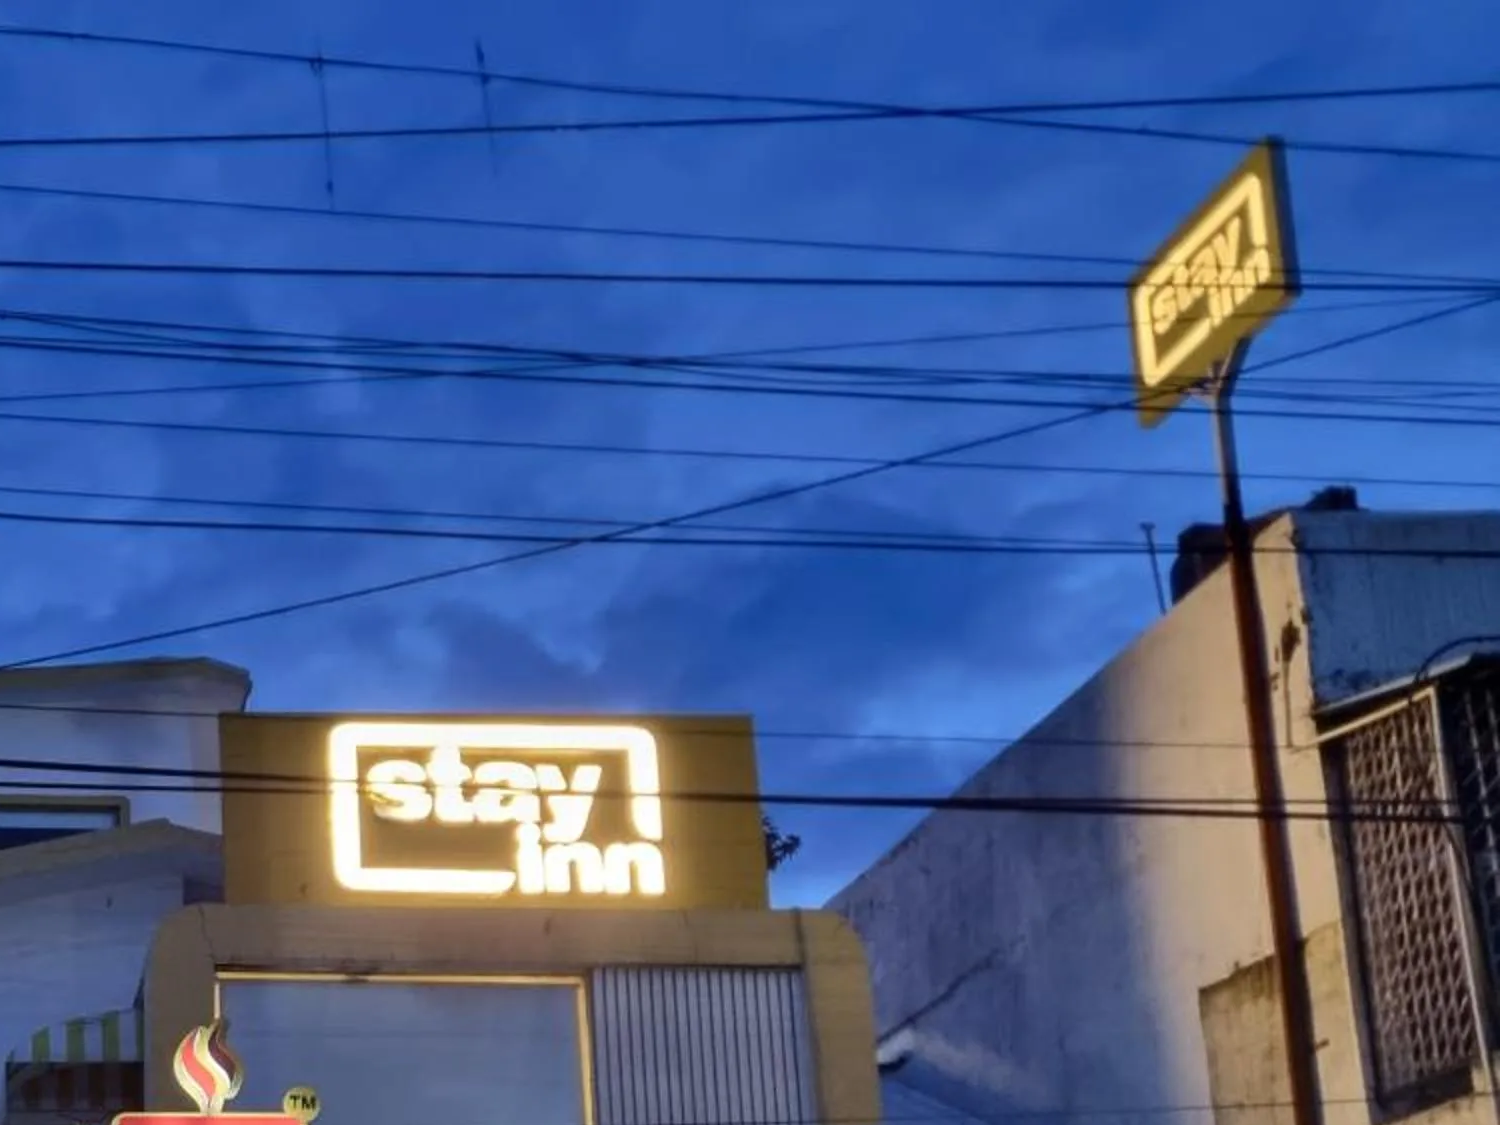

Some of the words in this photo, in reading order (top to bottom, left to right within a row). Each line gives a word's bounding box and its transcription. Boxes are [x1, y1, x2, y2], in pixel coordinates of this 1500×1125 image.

[1152, 215, 1241, 335] stay
[1207, 247, 1271, 328] inn
[364, 744, 603, 843] stay
[515, 821, 666, 895] inn
[288, 1095, 317, 1111] TM
